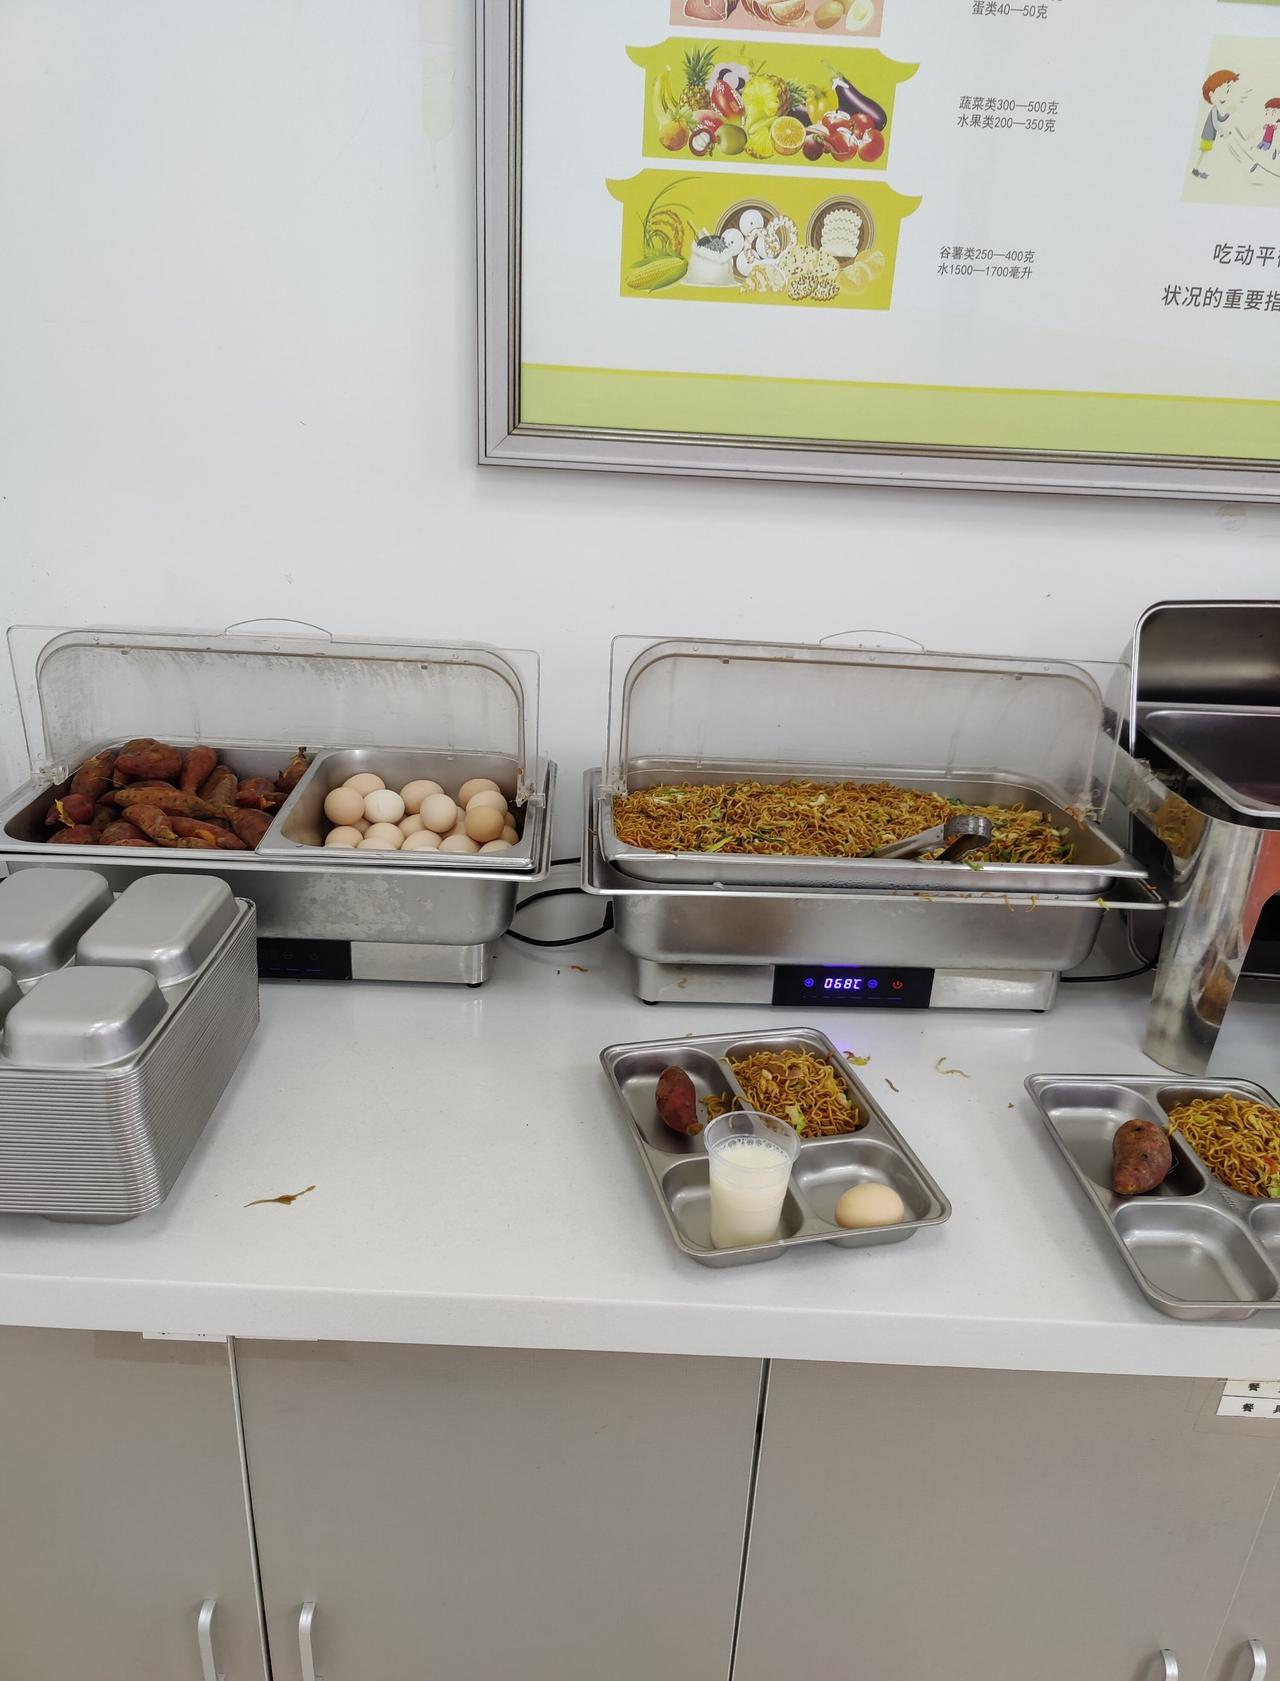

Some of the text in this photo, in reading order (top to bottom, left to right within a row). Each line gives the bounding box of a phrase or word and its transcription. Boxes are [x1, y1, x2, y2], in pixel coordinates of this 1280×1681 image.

[959, 95, 1059, 115] 蔬菜类300—500克
[957, 113, 1056, 133] 水果类200—350克
[940, 245, 1035, 263] 谷薯类250—400克
[1213, 243, 1280, 267] 吃动平
[937, 262, 1033, 279] 水1500—1700毫升
[1162, 284, 1280, 312] 状况的重要指
